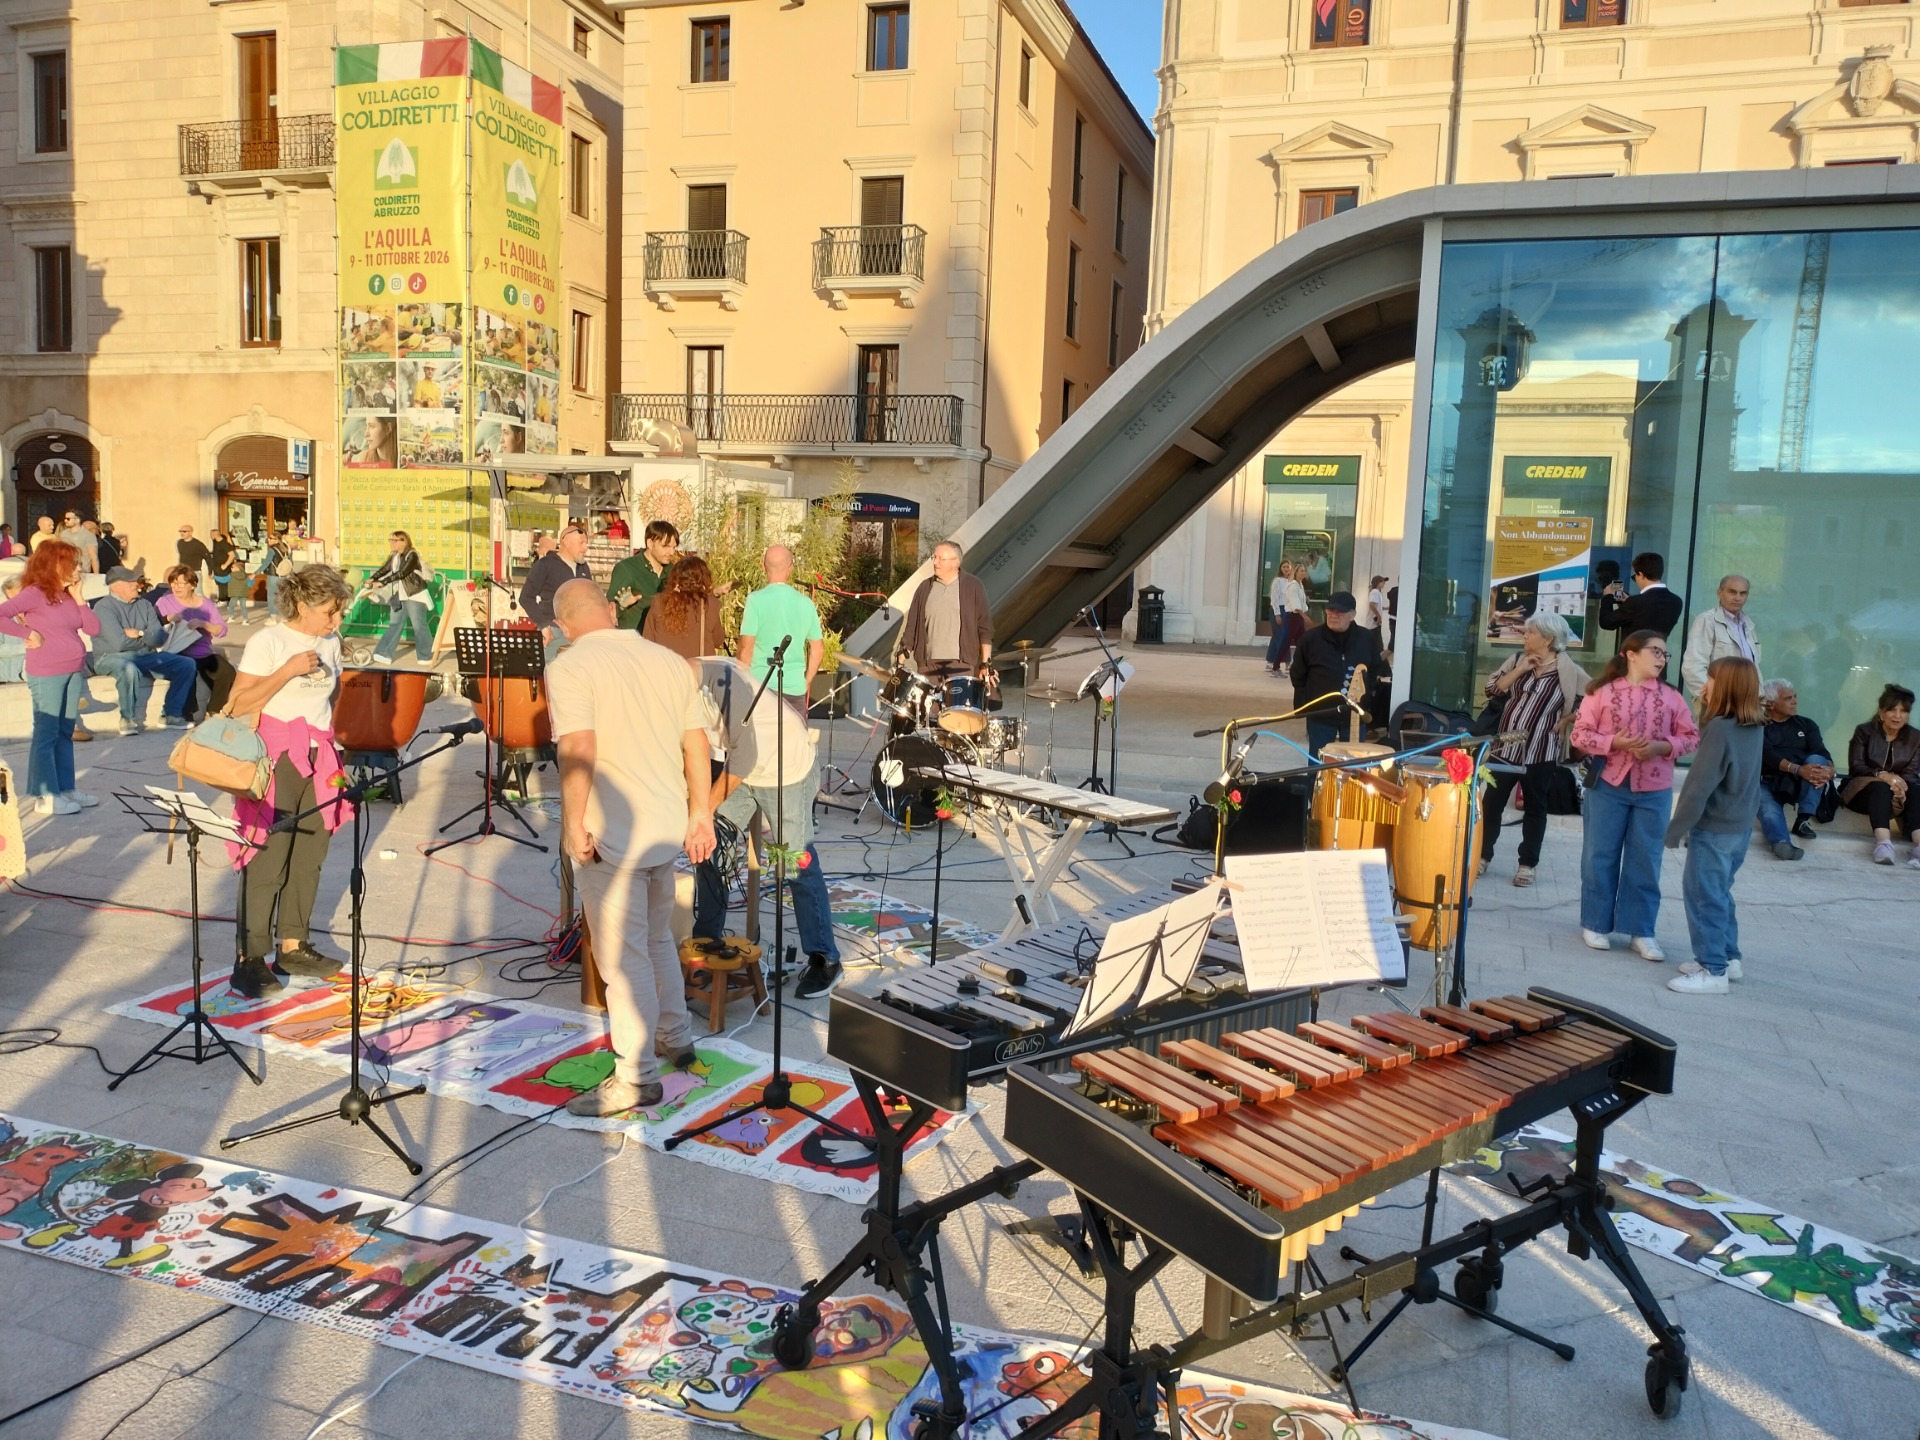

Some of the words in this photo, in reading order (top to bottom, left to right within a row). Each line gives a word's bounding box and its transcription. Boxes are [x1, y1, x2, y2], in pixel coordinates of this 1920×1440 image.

[358, 86, 439, 105] VILLAGGIO
[342, 104, 459, 131] COLDIRETTI
[489, 96, 546, 138] VILLAGGIO
[475, 111, 558, 167] COLDIRETTI
[374, 194, 420, 207] COLDIRETTI
[374, 206, 420, 217] ABRUZZO
[506, 209, 540, 230] COLDIRETTI
[364, 227, 431, 250] L'AQUILA
[507, 219, 540, 240] ABRUZZO
[350, 256, 355, 267] 9
[365, 254, 373, 266] 11
[376, 252, 420, 266] OTTOBRE
[424, 251, 450, 264] 2026
[500, 238, 547, 272] L'AQUILA
[484, 257, 490, 269] 9
[500, 261, 508, 275] 11
[511, 267, 541, 288] OTTOBRE
[40, 464, 74, 477] BAR
[1283, 464, 1339, 476] CREDEM
[1526, 465, 1587, 478] CREDEM
[43, 479, 76, 487] ARISTON
[240, 472, 289, 490] Guerriero
[889, 504, 912, 513] librerie
[1500, 530, 1518, 539] Non
[1521, 530, 1586, 541] Abbandonarmi
[1002, 1037, 1039, 1060] ADAMS
